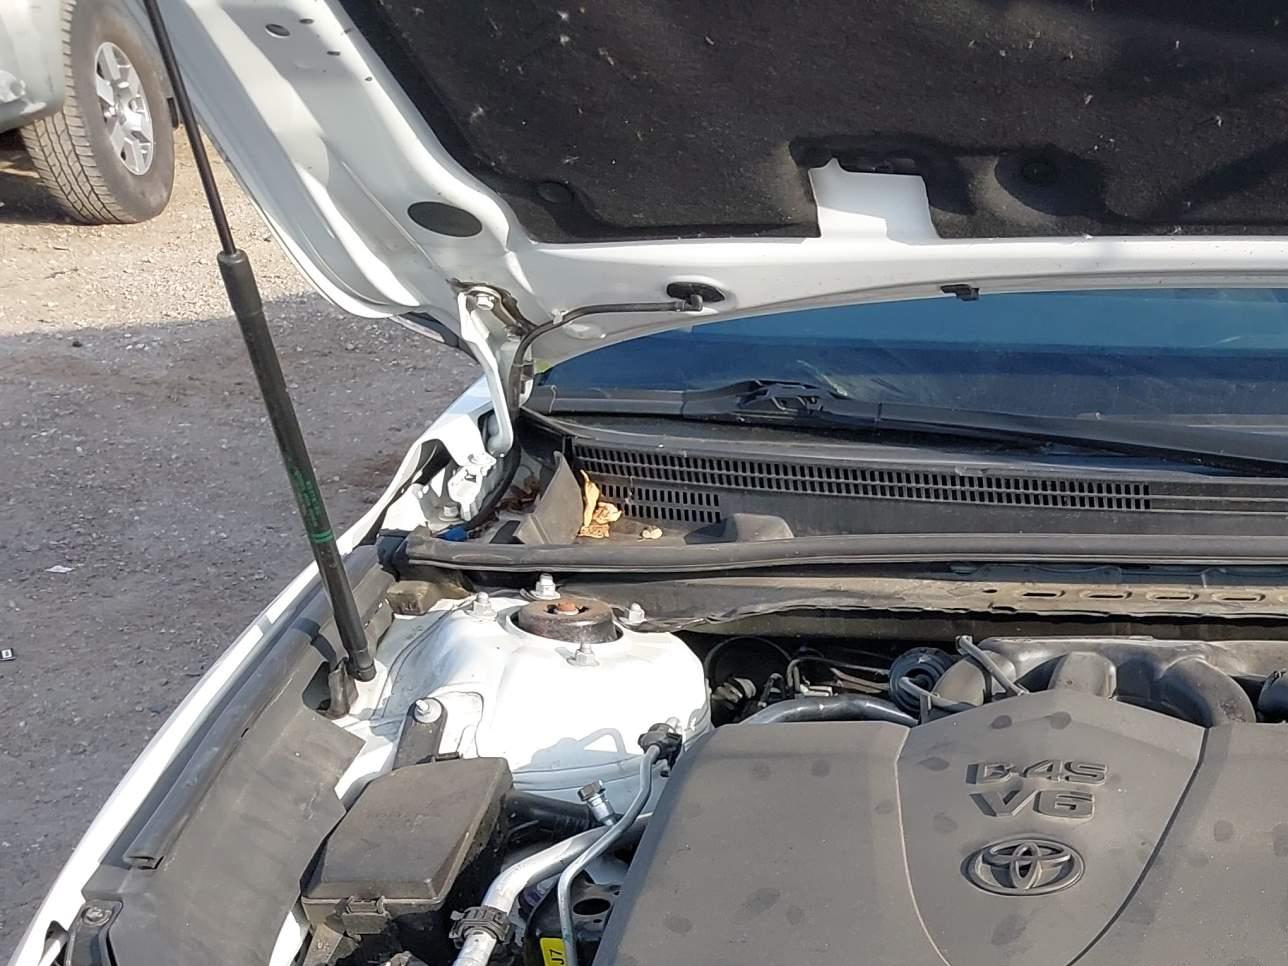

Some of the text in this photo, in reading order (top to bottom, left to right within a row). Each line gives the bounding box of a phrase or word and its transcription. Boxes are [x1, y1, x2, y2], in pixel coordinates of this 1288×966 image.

[966, 759, 1108, 785] D-4S
[970, 790, 1096, 819] V6
[549, 949, 565, 966] J7
